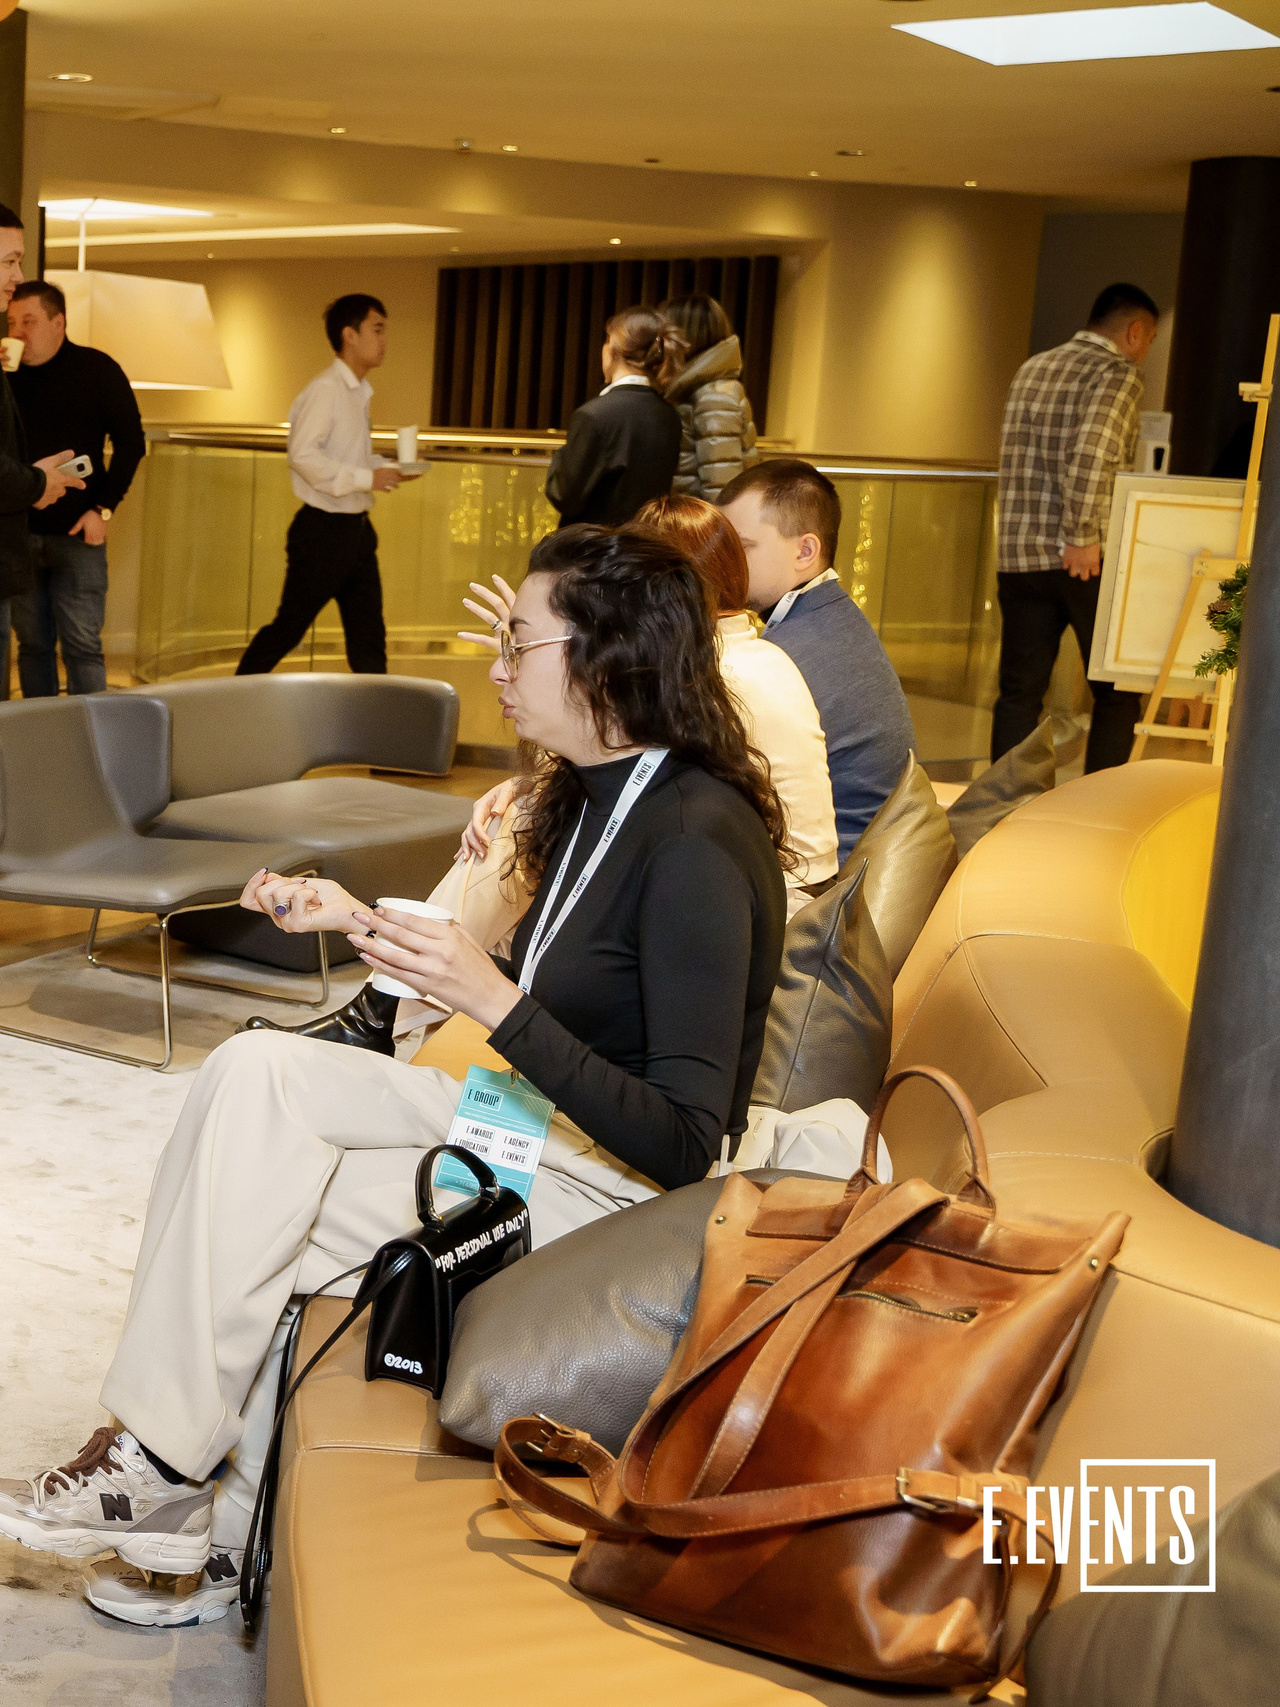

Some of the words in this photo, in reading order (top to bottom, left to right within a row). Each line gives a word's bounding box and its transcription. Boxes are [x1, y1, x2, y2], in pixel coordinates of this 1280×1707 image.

[455, 1231, 493, 1263] PERSONAL
[492, 1223, 506, 1242] USE
[99, 1493, 133, 1522] N
